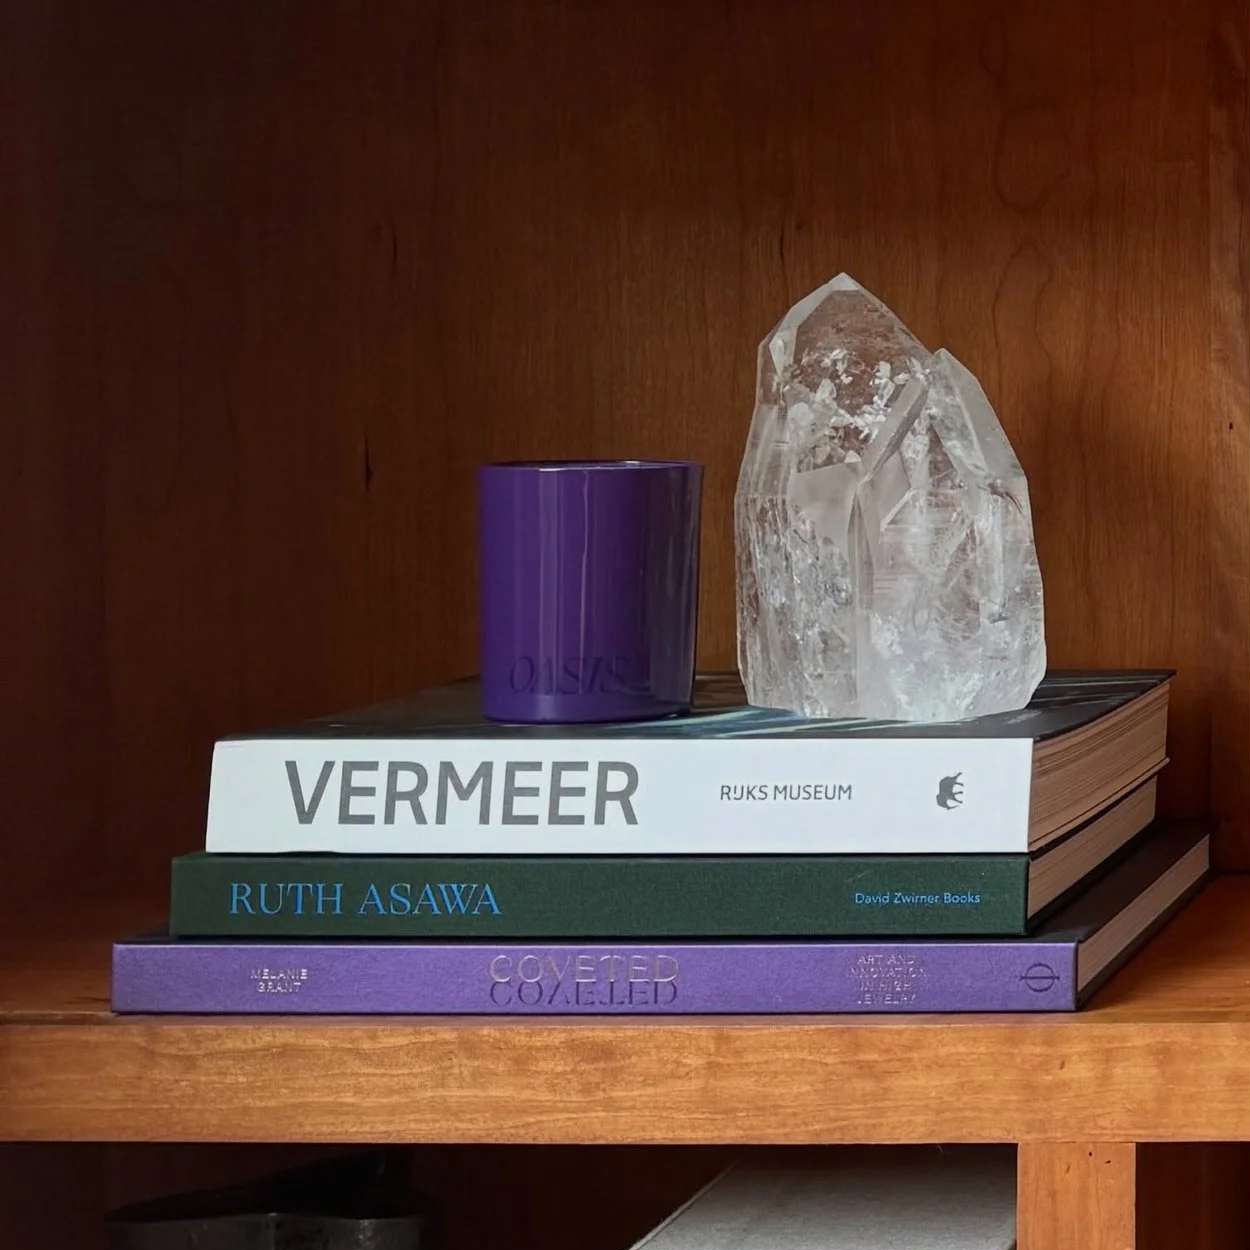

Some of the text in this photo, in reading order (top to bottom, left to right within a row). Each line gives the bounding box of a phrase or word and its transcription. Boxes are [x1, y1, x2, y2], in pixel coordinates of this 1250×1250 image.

[285, 760, 640, 825] VERMEER
[773, 784, 853, 801] MUSEUM
[229, 883, 502, 915] RUTH ASAWA
[854, 890, 981, 904] David Zwirner Books
[489, 954, 680, 983] COVETED
